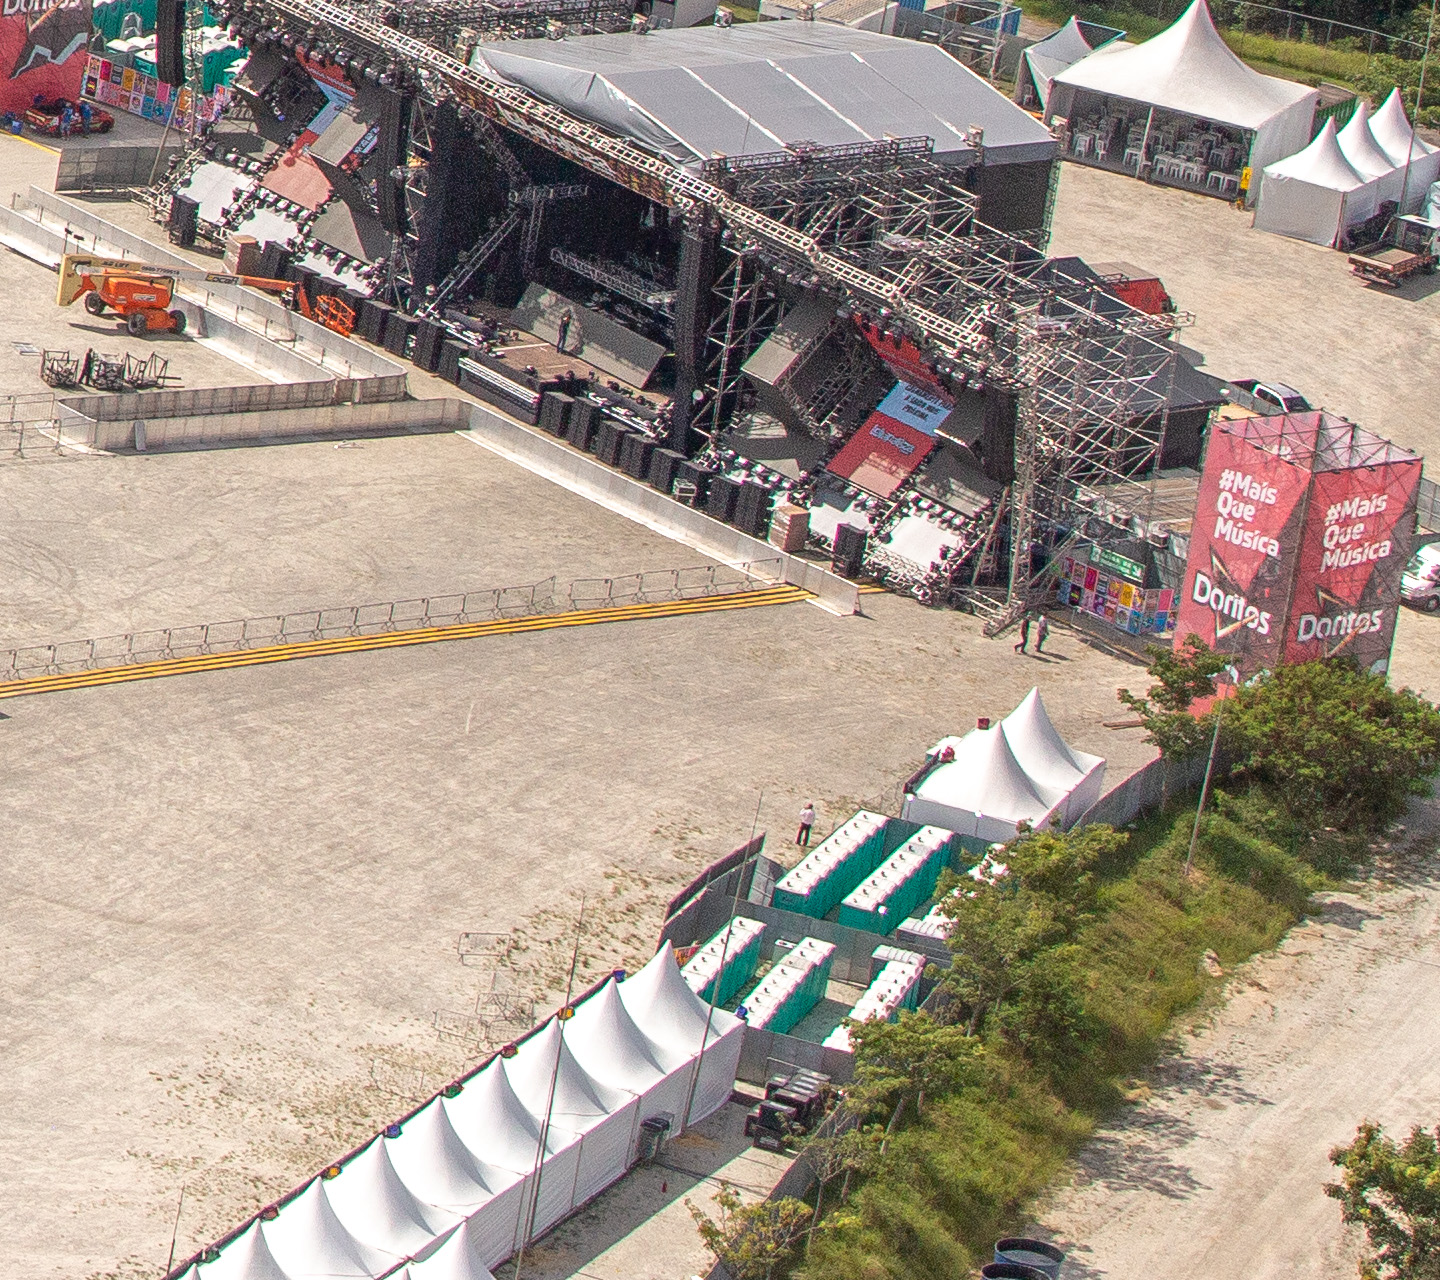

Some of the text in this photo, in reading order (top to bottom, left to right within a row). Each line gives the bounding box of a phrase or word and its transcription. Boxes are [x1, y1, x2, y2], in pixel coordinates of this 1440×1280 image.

[1218, 469, 1278, 506] #Mais
[1217, 491, 1256, 522] Que
[1324, 493, 1388, 526] #Mais
[1214, 517, 1280, 557] Música
[1323, 522, 1365, 550] Que
[1320, 540, 1391, 573] Música
[1192, 572, 1272, 636] Doritos
[1297, 609, 1384, 643] Doritos
